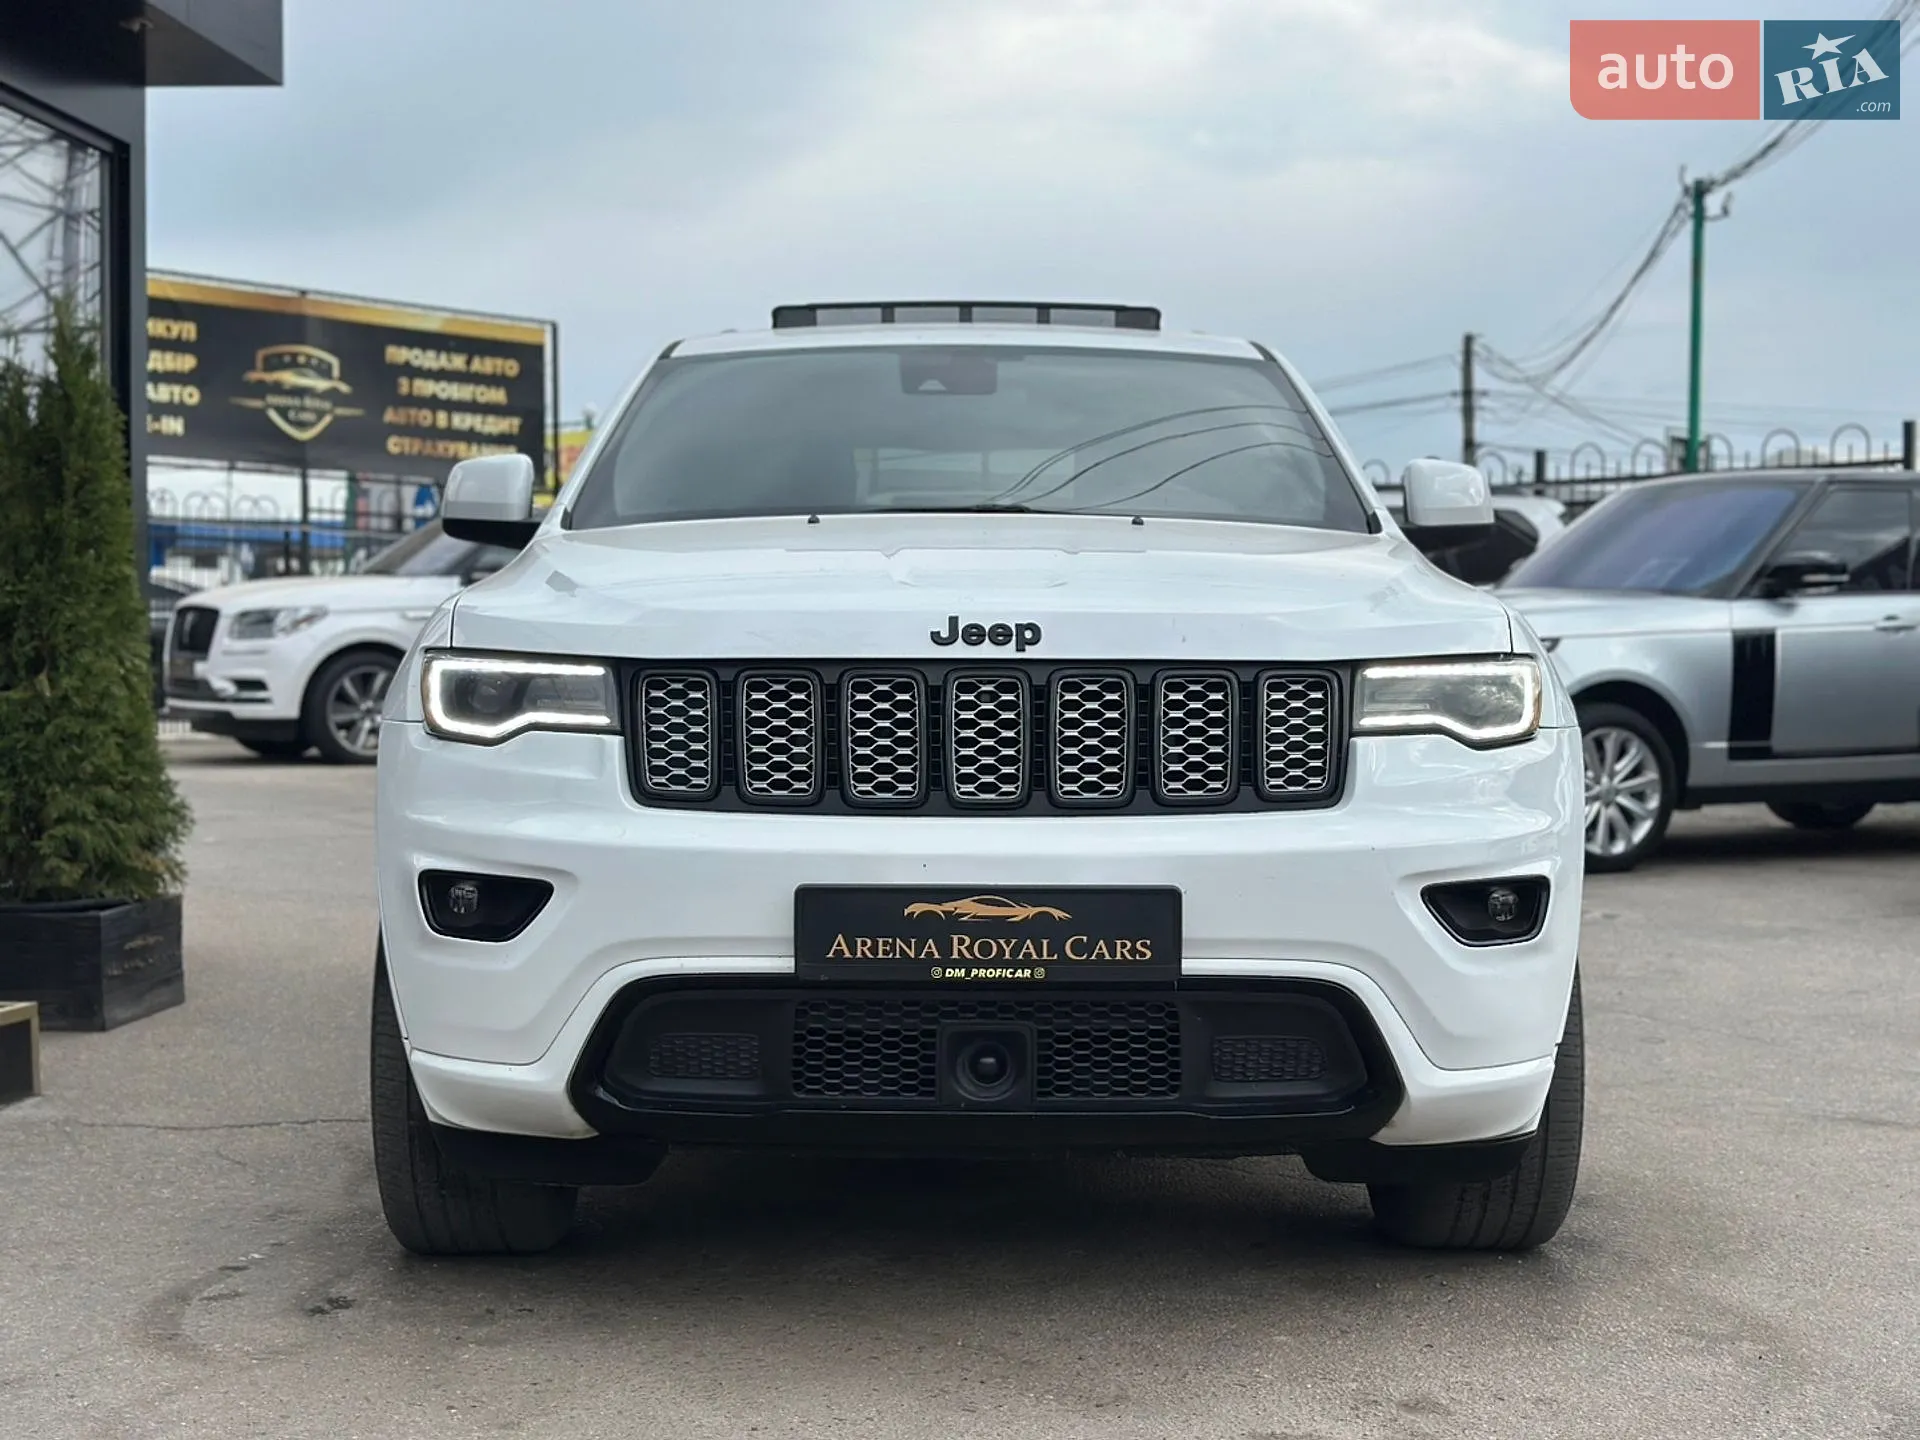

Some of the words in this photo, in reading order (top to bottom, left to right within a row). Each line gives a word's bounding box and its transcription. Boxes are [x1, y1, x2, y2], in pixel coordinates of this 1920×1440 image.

[385, 345, 468, 372] ПРОДАЖ
[469, 355, 520, 378] АВТО
[411, 377, 508, 406] ПРОБІГОМ
[383, 406, 434, 428] АВТО
[451, 411, 523, 436] КРЕДИТ
[930, 615, 1042, 652] Jeep
[944, 967, 1032, 981] DM_PROFICAR
